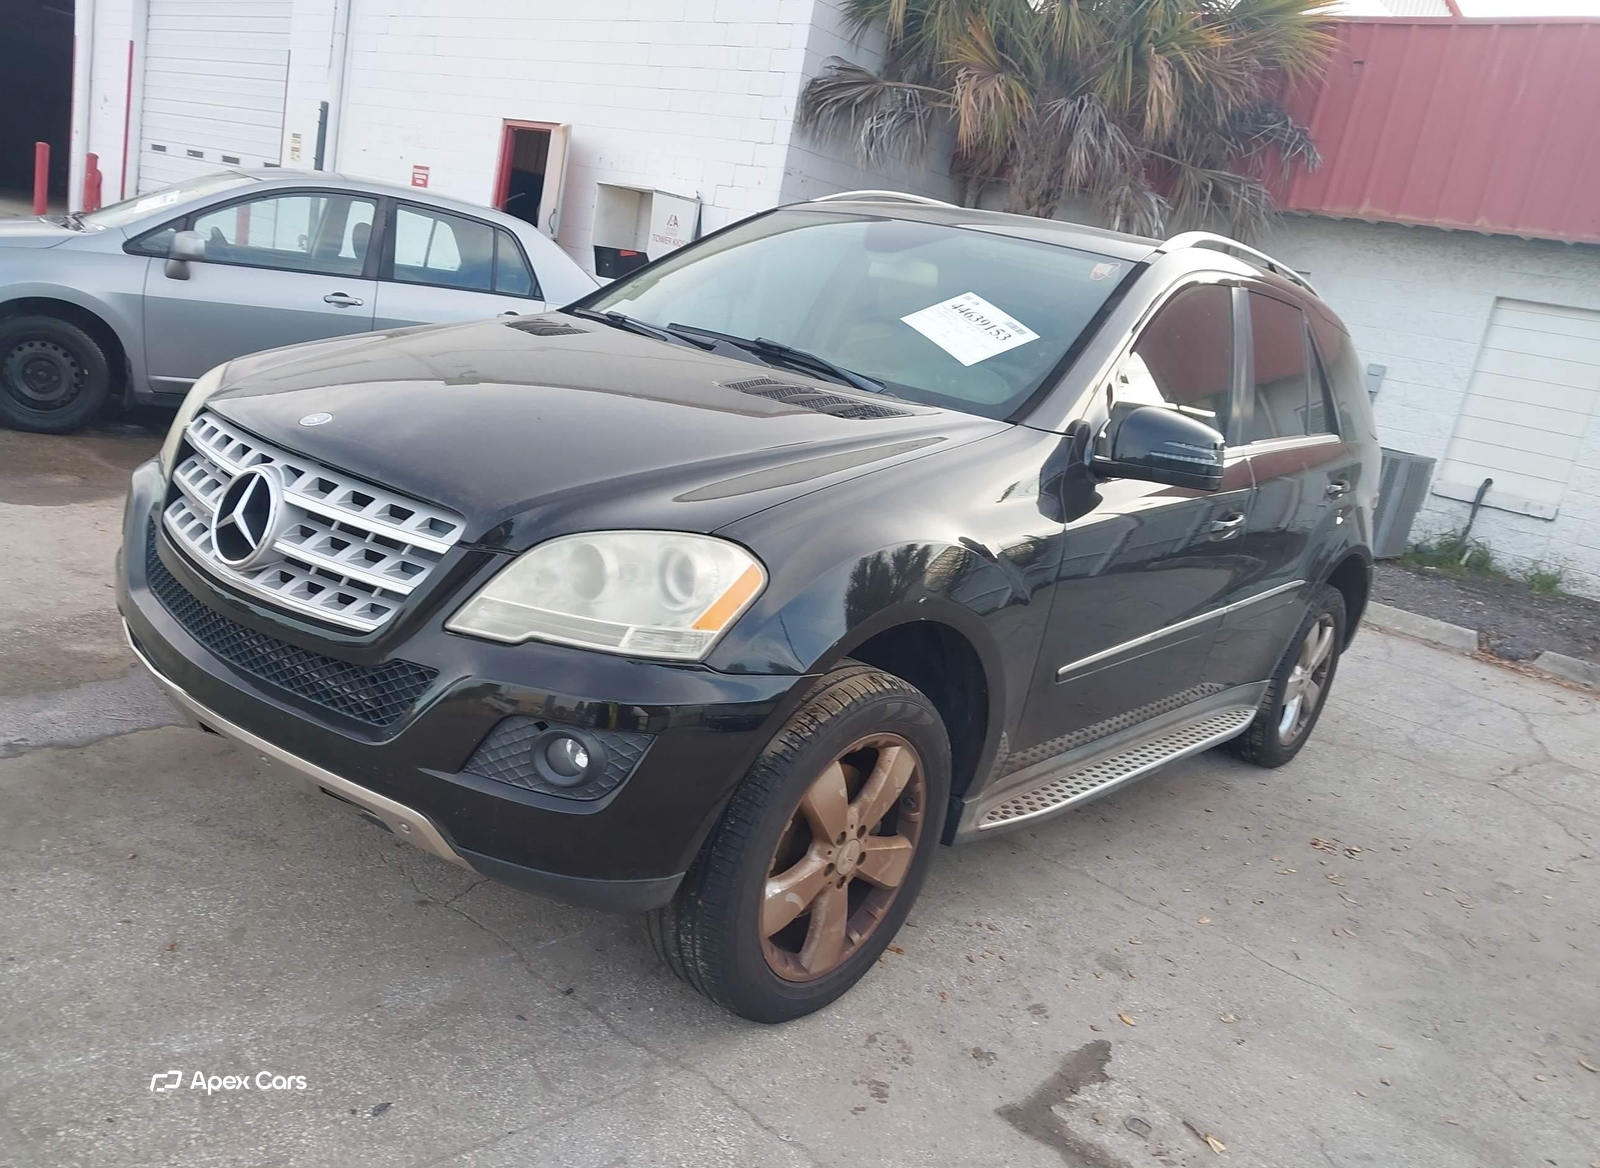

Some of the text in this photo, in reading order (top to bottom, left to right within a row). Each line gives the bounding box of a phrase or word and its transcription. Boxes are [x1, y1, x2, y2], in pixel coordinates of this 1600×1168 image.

[652, 233, 688, 247] TOWER KIOS
[951, 303, 1012, 341] 44639153
